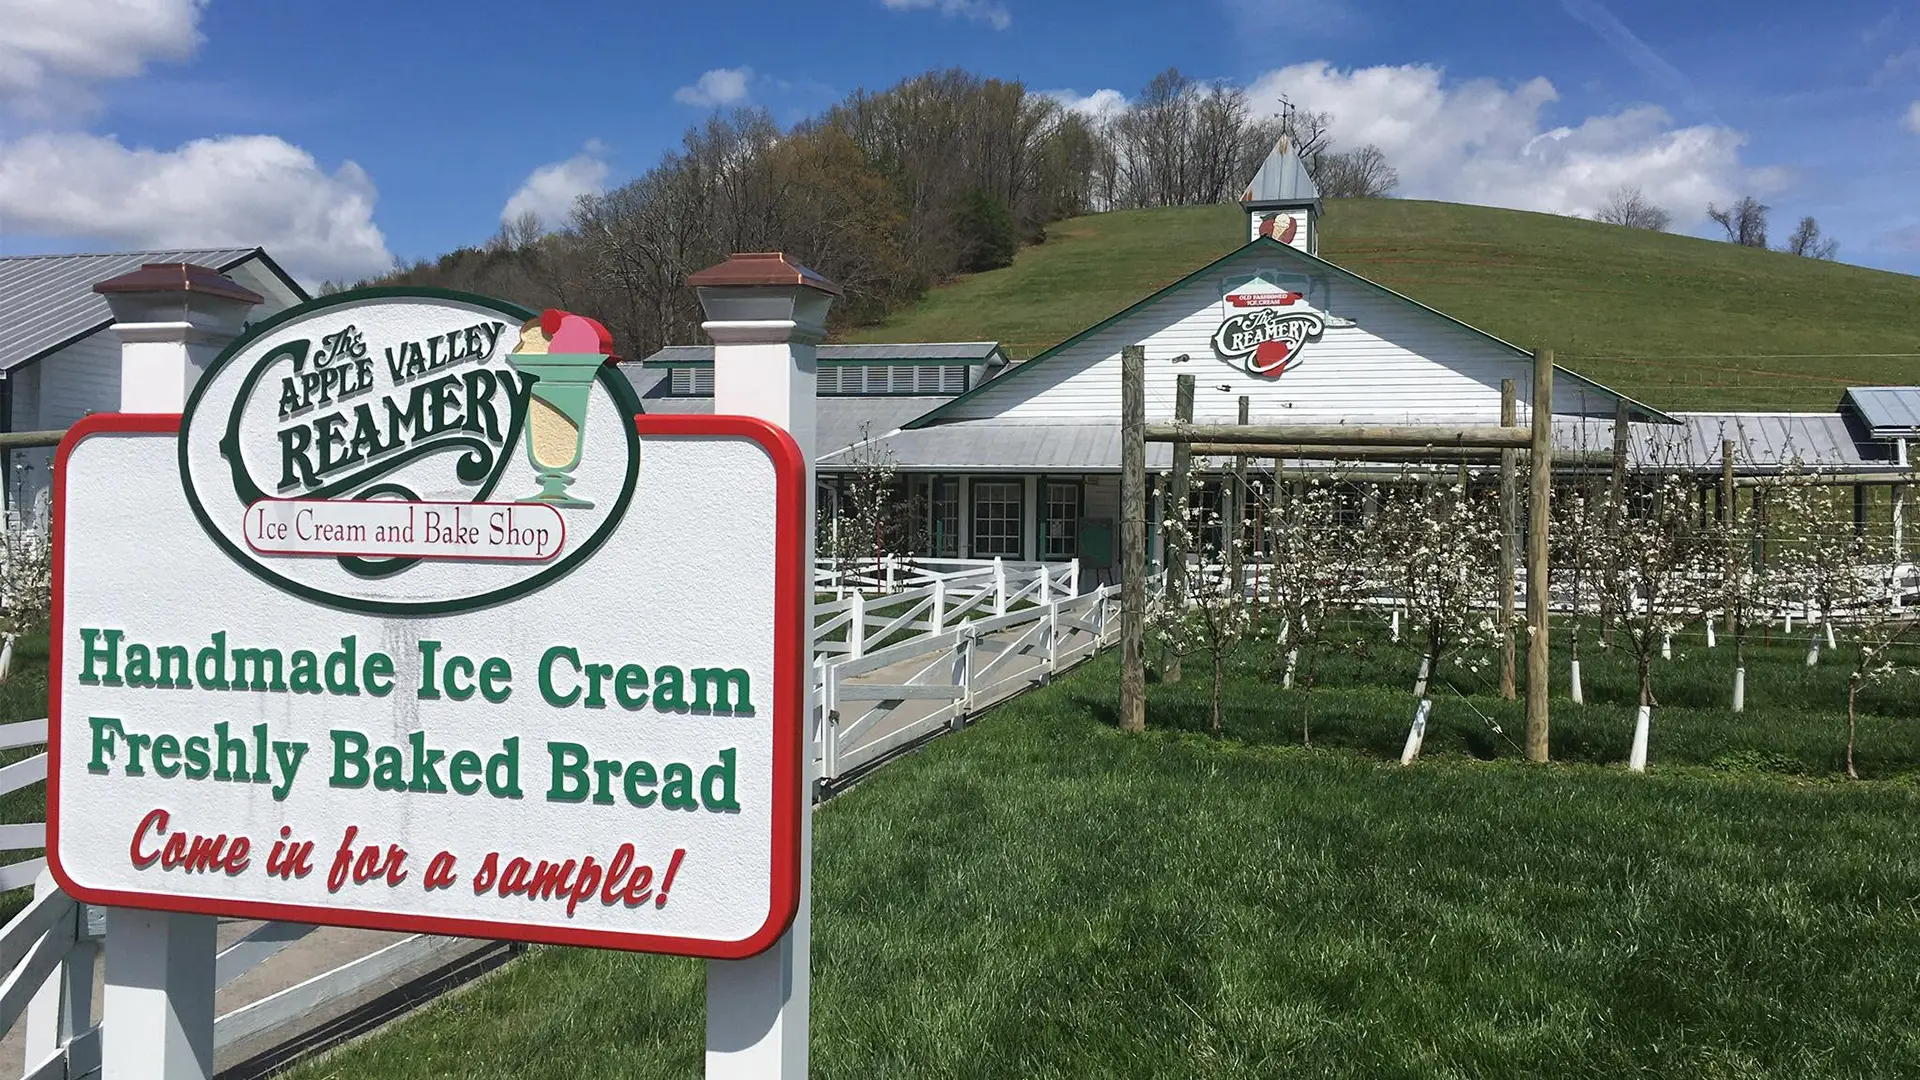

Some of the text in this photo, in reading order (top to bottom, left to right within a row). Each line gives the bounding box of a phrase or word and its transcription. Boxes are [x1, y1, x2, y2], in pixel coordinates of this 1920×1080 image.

[314, 325, 367, 368] The
[1214, 313, 1322, 360] CREAMERY
[1242, 309, 1276, 331] The
[278, 321, 504, 420] APPLE VALLEY
[220, 338, 540, 506] CREAMERY
[257, 508, 549, 556] Ice Cream and Bake Shop
[79, 628, 755, 714] Handmade Ice Cream
[88, 717, 741, 811] Freshly Baked Bread
[130, 808, 686, 916] Come in for a sample!
